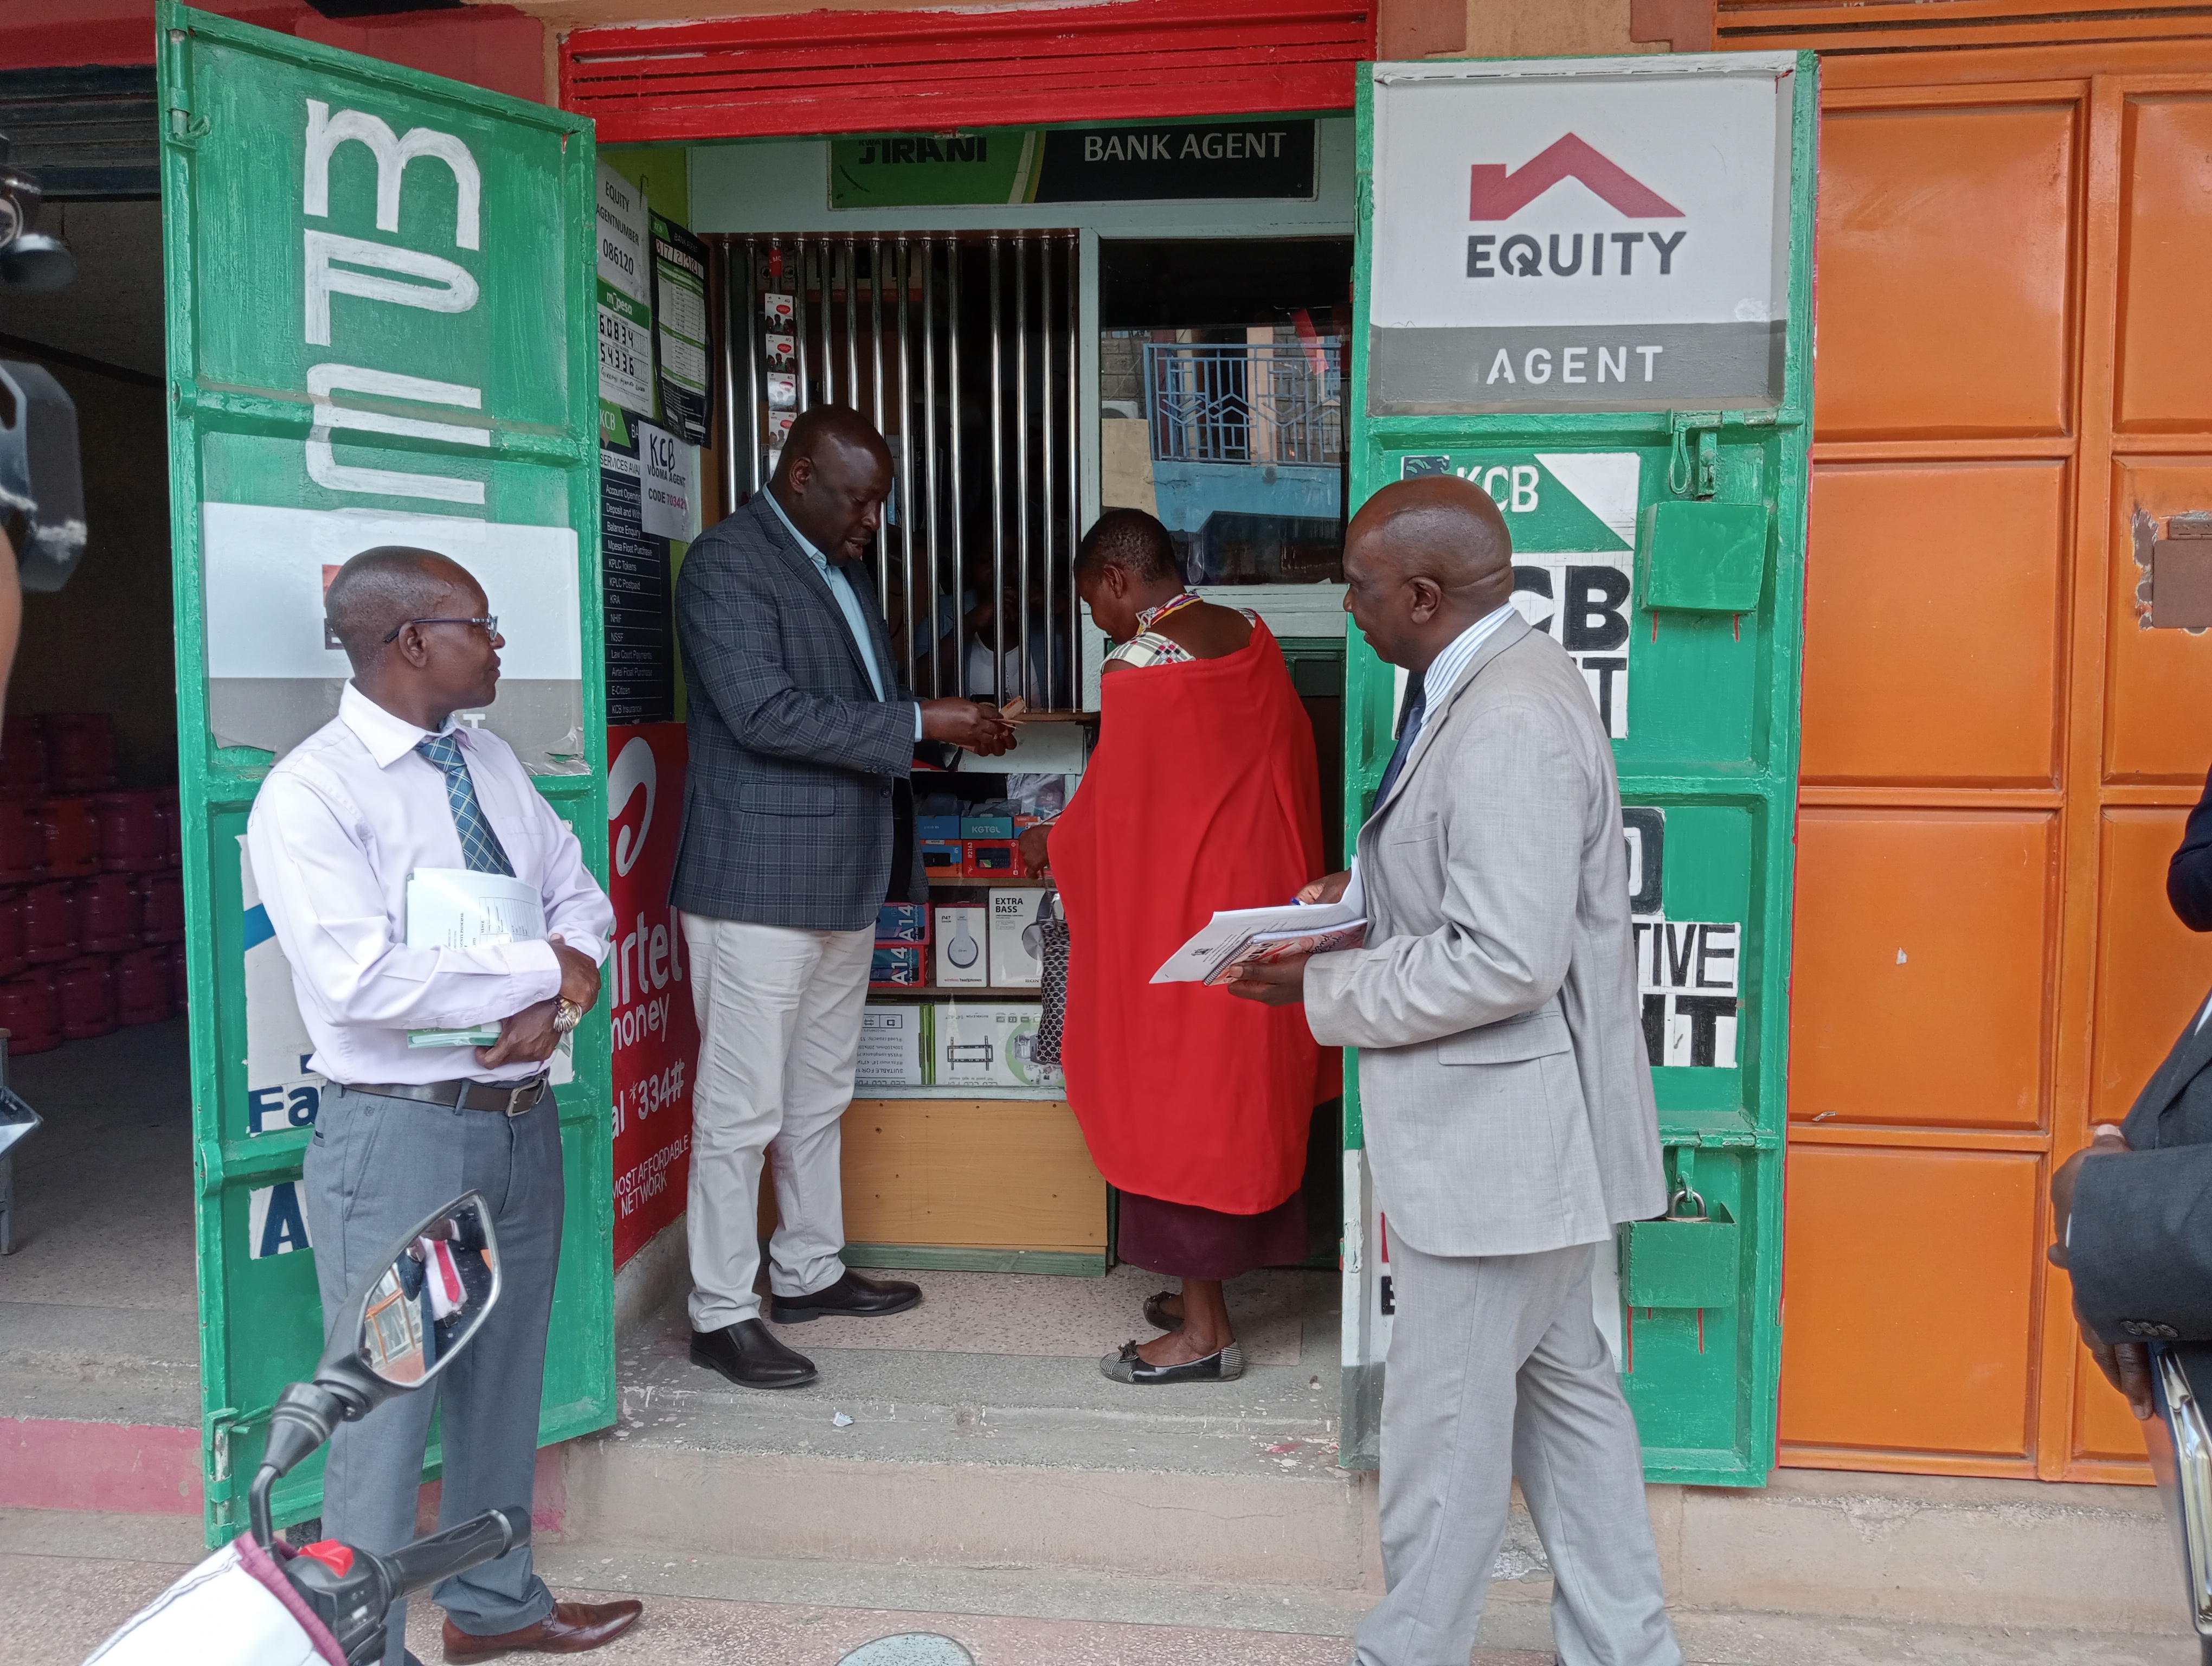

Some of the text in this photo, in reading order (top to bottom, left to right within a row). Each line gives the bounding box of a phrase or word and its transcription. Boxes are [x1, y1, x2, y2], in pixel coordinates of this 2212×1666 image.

[859, 137, 987, 164] JIRANI
[1084, 132, 1287, 162] BANK AGENT
[606, 181, 629, 212] EQUITY
[596, 203, 639, 246] AGENTNUMBER
[603, 238, 634, 275] 086120
[1466, 231, 1688, 278] EQUITY
[599, 313, 634, 348] 60834
[600, 342, 634, 376] 54336
[1486, 345, 1663, 385] AGENT
[600, 408, 616, 431] KCB
[631, 424, 640, 438] BA
[600, 453, 628, 472] SERVICES
[650, 433, 676, 472] KCB
[647, 464, 685, 488] VOOMA AGENT
[1456, 464, 1540, 512] KCB
[606, 484, 641, 504] Account Opening
[648, 488, 665, 504] CODE
[606, 503, 622, 516] Deposit
[623, 508, 632, 517] and
[607, 521, 641, 539] Balance Enquiry
[608, 540, 653, 556] Mpesa Float Purchase
[608, 559, 637, 572] KPLC Tokens
[609, 576, 641, 591] KPLC Postpaid
[610, 594, 621, 604] KRA
[1512, 565, 1631, 651] CB
[610, 613, 622, 623] NHIF
[610, 632, 624, 642] NSSF
[611, 649, 620, 659] Law
[621, 649, 633, 659] Court
[611, 667, 623, 677] Airtel
[623, 667, 634, 677] Float
[611, 685, 631, 695] E-Citizen
[612, 704, 642, 714] KCB Insurance
[898, 905, 914, 942] A14
[609, 904, 683, 1010] irtel
[890, 947, 908, 985] A14
[612, 1090, 625, 1140] al
[638, 1134, 689, 1183] AFFORDABLE
[621, 1170, 668, 1219] NETWORK
